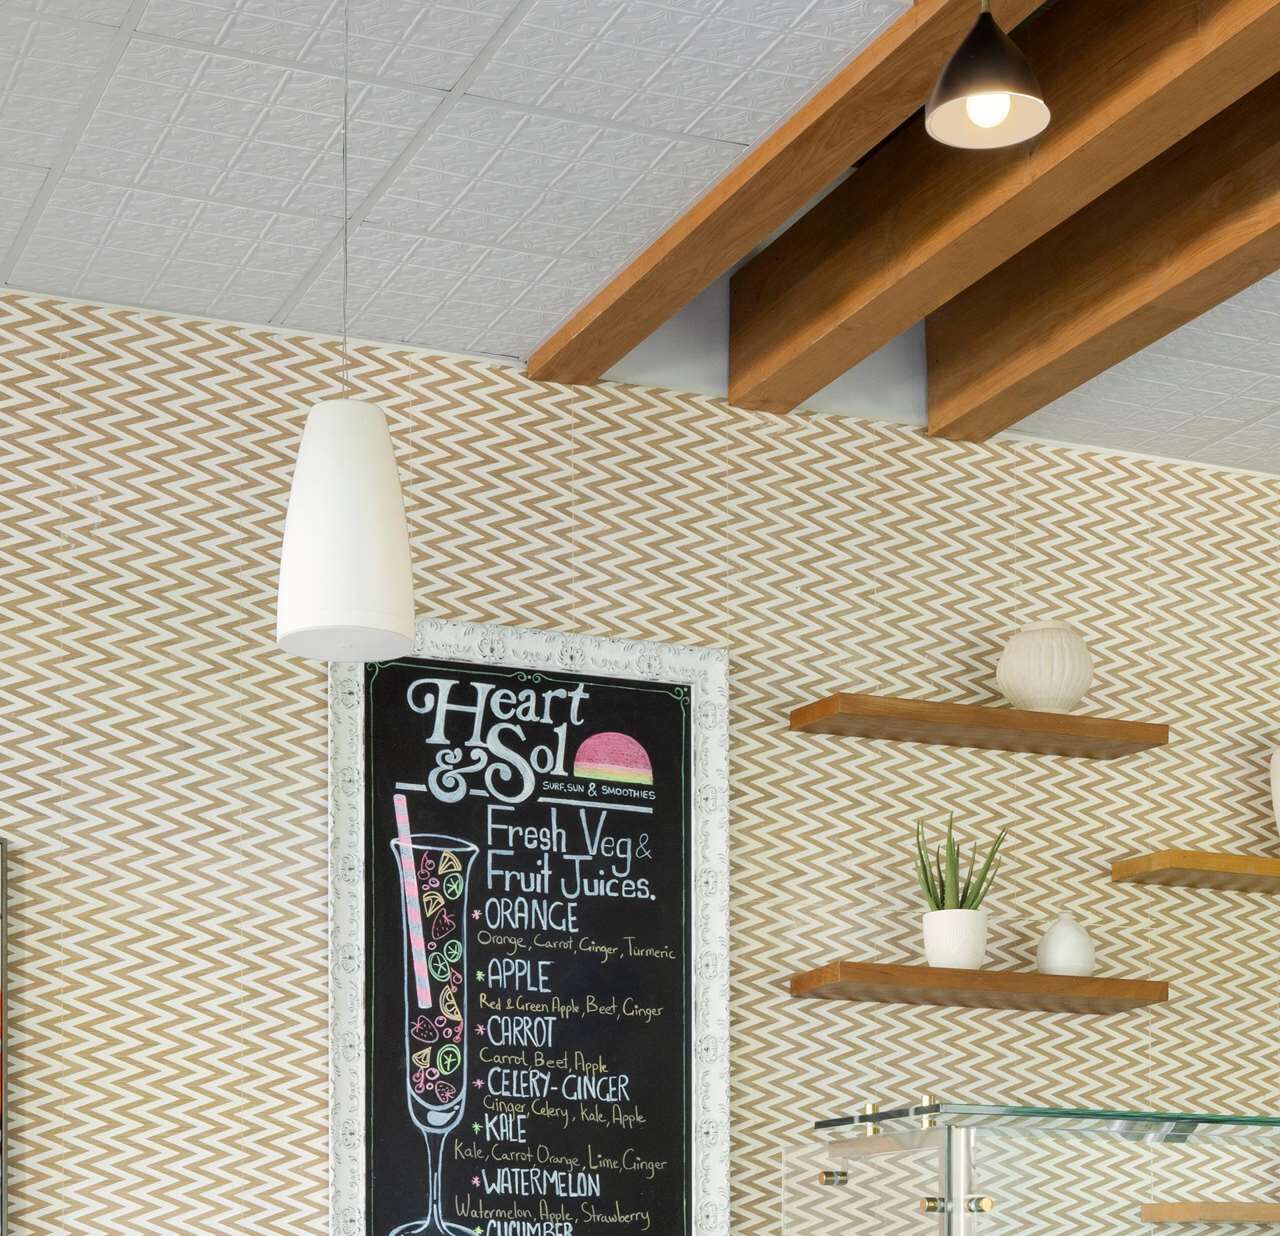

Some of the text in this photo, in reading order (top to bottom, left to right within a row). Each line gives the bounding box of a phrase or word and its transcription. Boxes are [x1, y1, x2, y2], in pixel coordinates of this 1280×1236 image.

[407, 678, 590, 747] Heart
[428, 722, 569, 804] & Sol
[588, 782, 598, 797] &
[601, 785, 656, 800] SMOOTHIES
[487, 804, 653, 878] Fresh Veg &
[487, 849, 657, 901] Fruit Juices.
[485, 896, 579, 933] ORANGE
[477, 930, 532, 956] Orange,
[624, 936, 677, 960] Turmeric
[488, 957, 555, 994] APPLE
[479, 993, 502, 1010] Red
[505, 997, 516, 1010] &
[516, 995, 549, 1013] Green
[622, 997, 665, 1024] Ginger
[487, 1014, 557, 1048] CARROT
[574, 1050, 609, 1077] Apple
[484, 1113, 527, 1143] KALE
[612, 1105, 648, 1129] Apple
[622, 1148, 668, 1179] Ginger
[481, 1167, 601, 1197] WATERMELON
[581, 1200, 651, 1231] Strawberry
